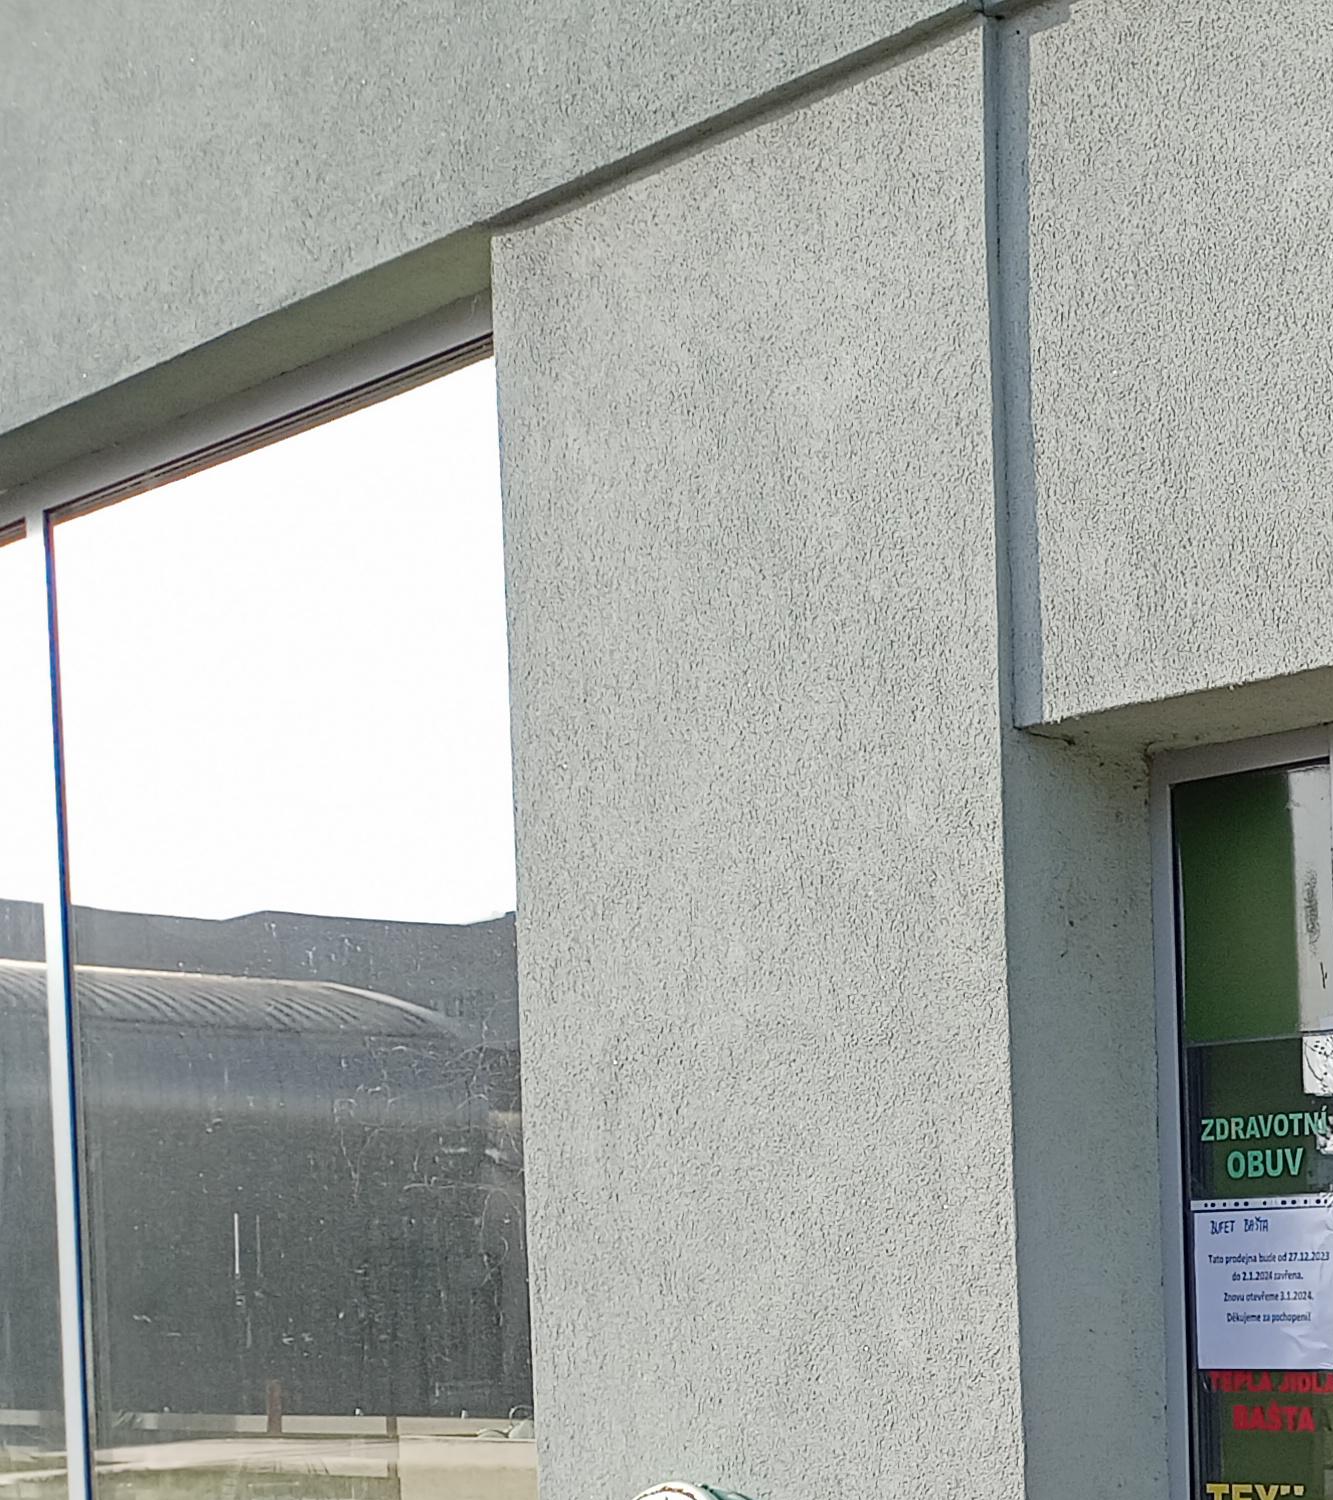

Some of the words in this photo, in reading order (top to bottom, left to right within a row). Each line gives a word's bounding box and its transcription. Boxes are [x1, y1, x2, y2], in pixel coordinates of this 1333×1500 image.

[1201, 1105, 1328, 1142] ZDRAVOTNÍ
[1227, 1148, 1304, 1179] OBUV
[1210, 1220, 1235, 1235] BUFET
[1244, 1215, 1269, 1232] BAŠTA
[1225, 1253, 1257, 1265] prodejna
[1259, 1252, 1276, 1263] bude
[1277, 1252, 1287, 1262] od
[1232, 1272, 1241, 1281] do
[1242, 1271, 1273, 1281] 2.1.2024
[1223, 1292, 1244, 1302] Znovu
[1226, 1312, 1261, 1324] Děkujeme
[1262, 1314, 1270, 1322] za
[1232, 1399, 1316, 1432] BAŠTA
